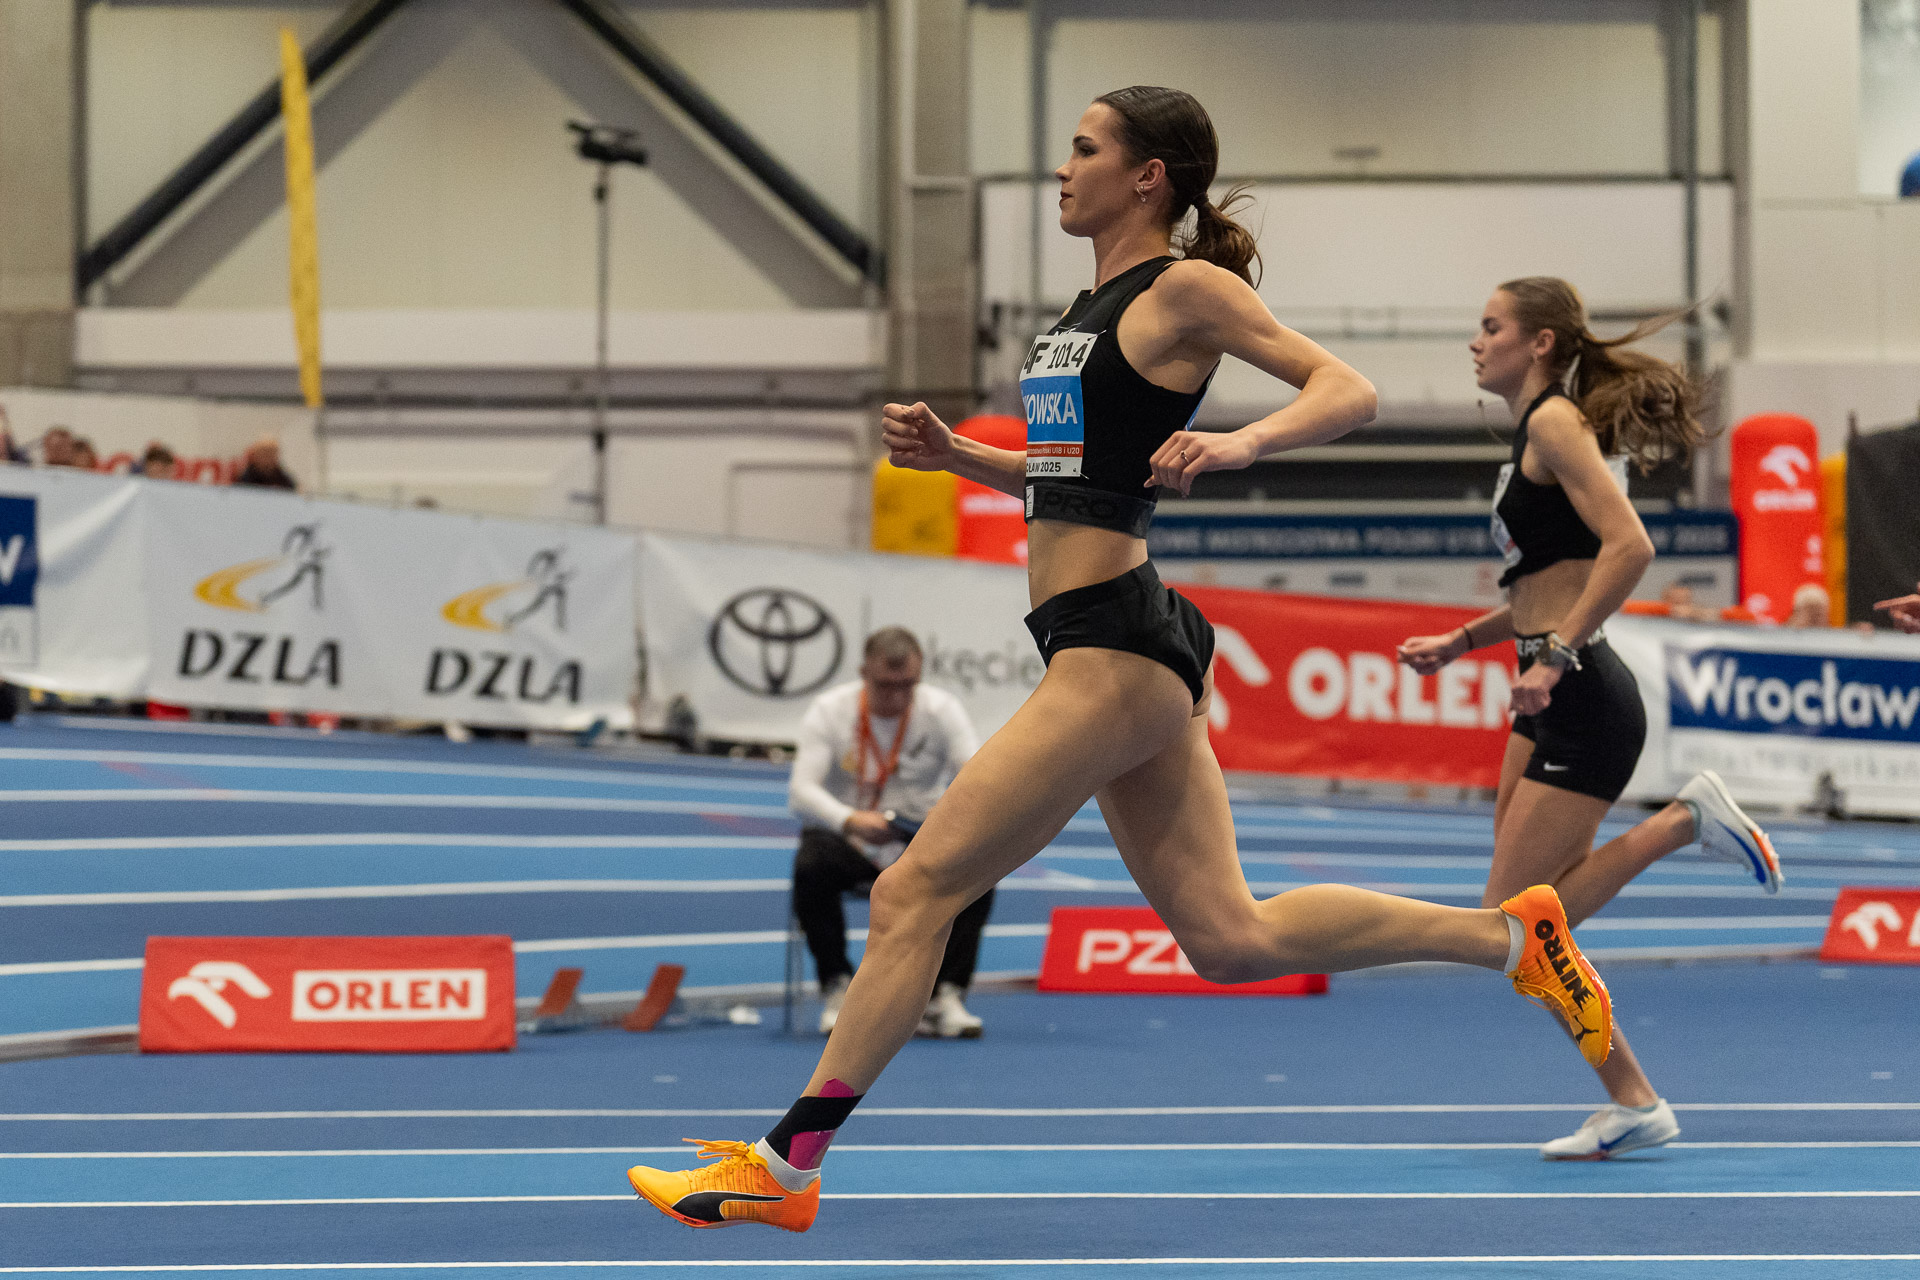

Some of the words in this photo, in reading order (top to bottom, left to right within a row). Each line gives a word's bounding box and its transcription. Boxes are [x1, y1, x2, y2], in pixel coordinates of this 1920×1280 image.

[1047, 342, 1088, 369] 1014
[1041, 462, 1061, 472] 2025
[1042, 490, 1117, 518] PRO
[178, 628, 341, 687] DZLA
[424, 648, 583, 703] DZLA
[1535, 919, 1597, 1014] NITRO
[307, 979, 469, 1010] ORLEN
